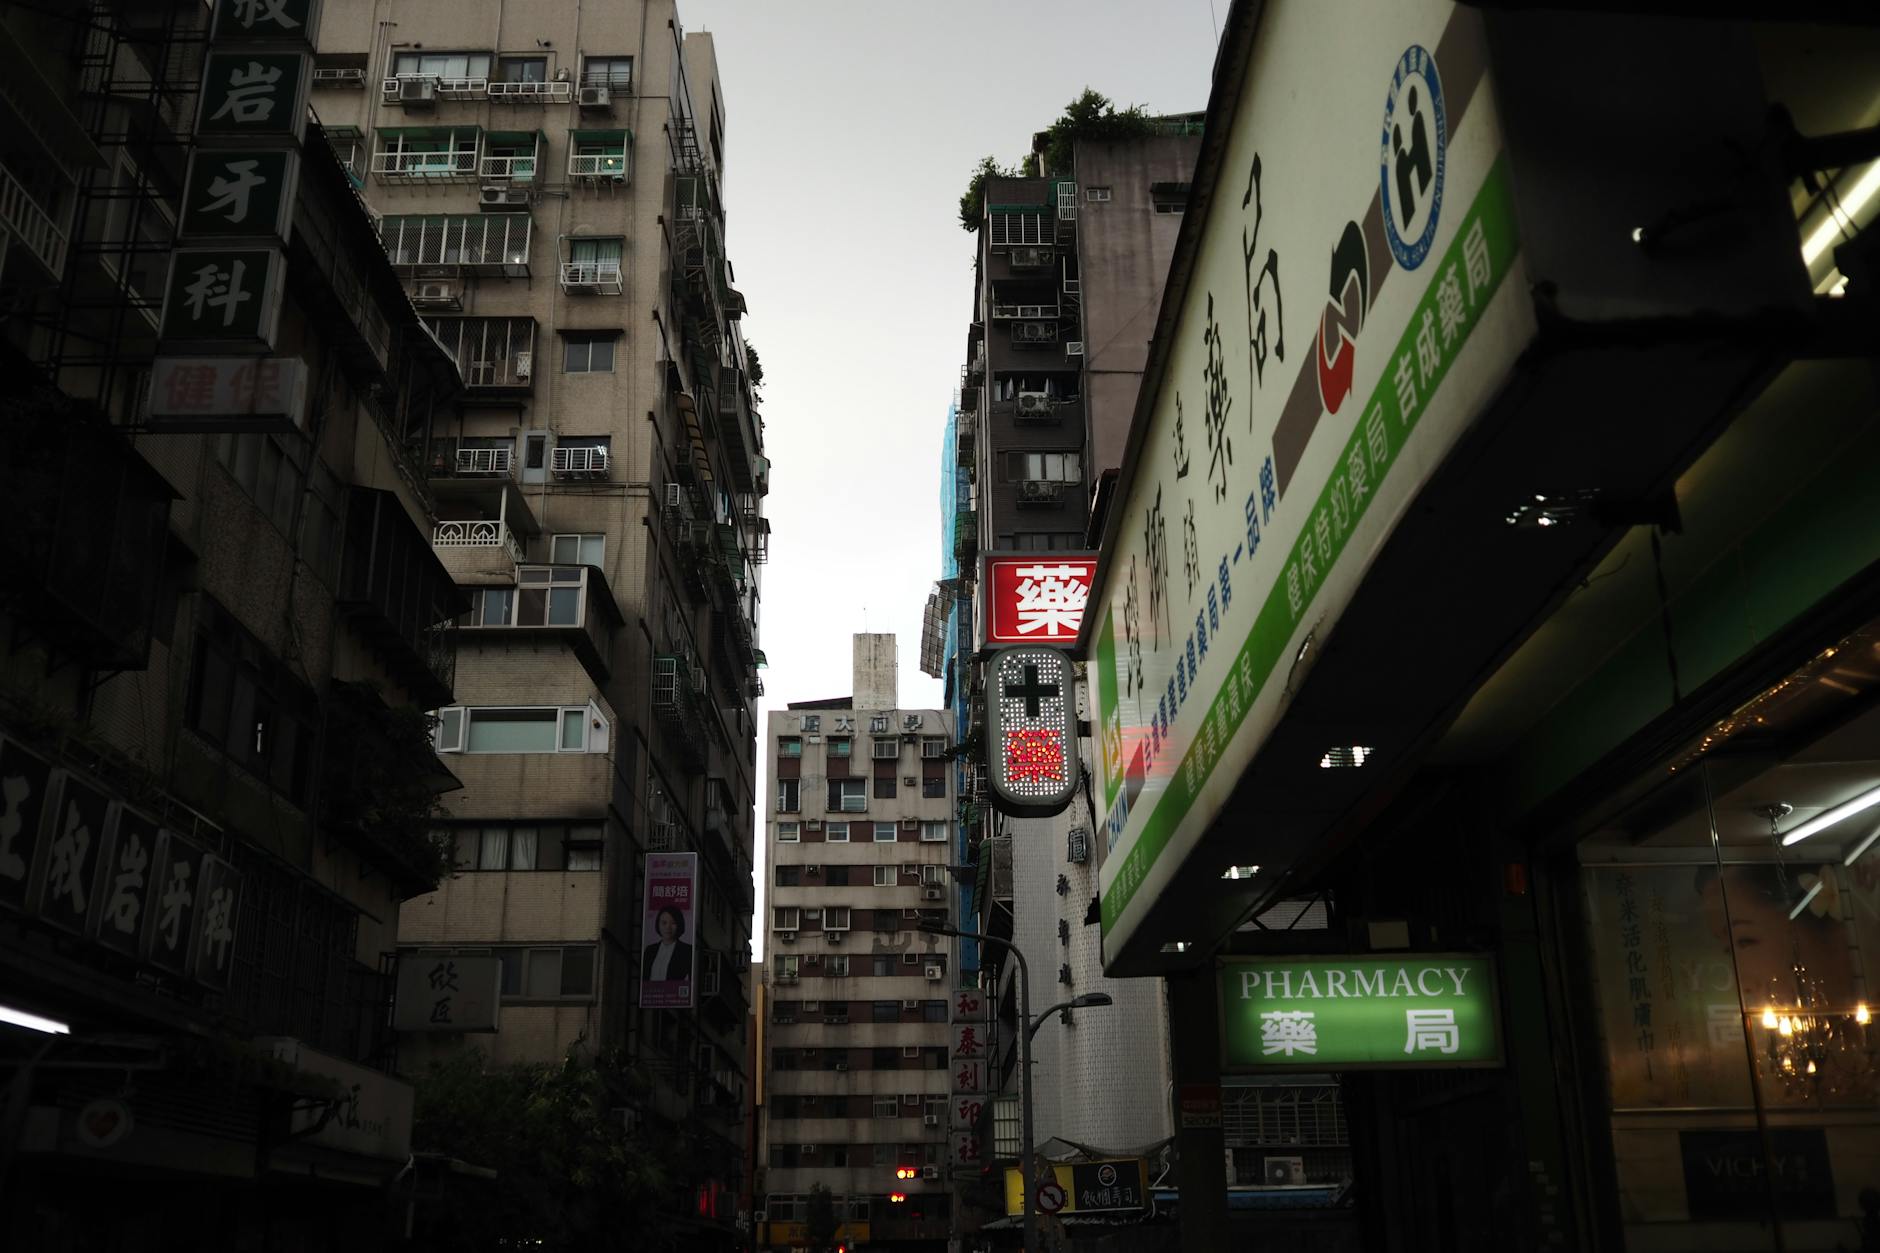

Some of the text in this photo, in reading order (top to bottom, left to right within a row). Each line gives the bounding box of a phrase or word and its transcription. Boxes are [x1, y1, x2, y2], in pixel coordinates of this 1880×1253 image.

[1392, 216, 1492, 427] 吉成藥局
[164, 362, 281, 411] 健保
[1015, 564, 1089, 636] 藥
[1107, 786, 1129, 854] CHAIN
[1239, 967, 1472, 1000] PHARMACY
[1259, 1008, 1460, 1057] 藥局
